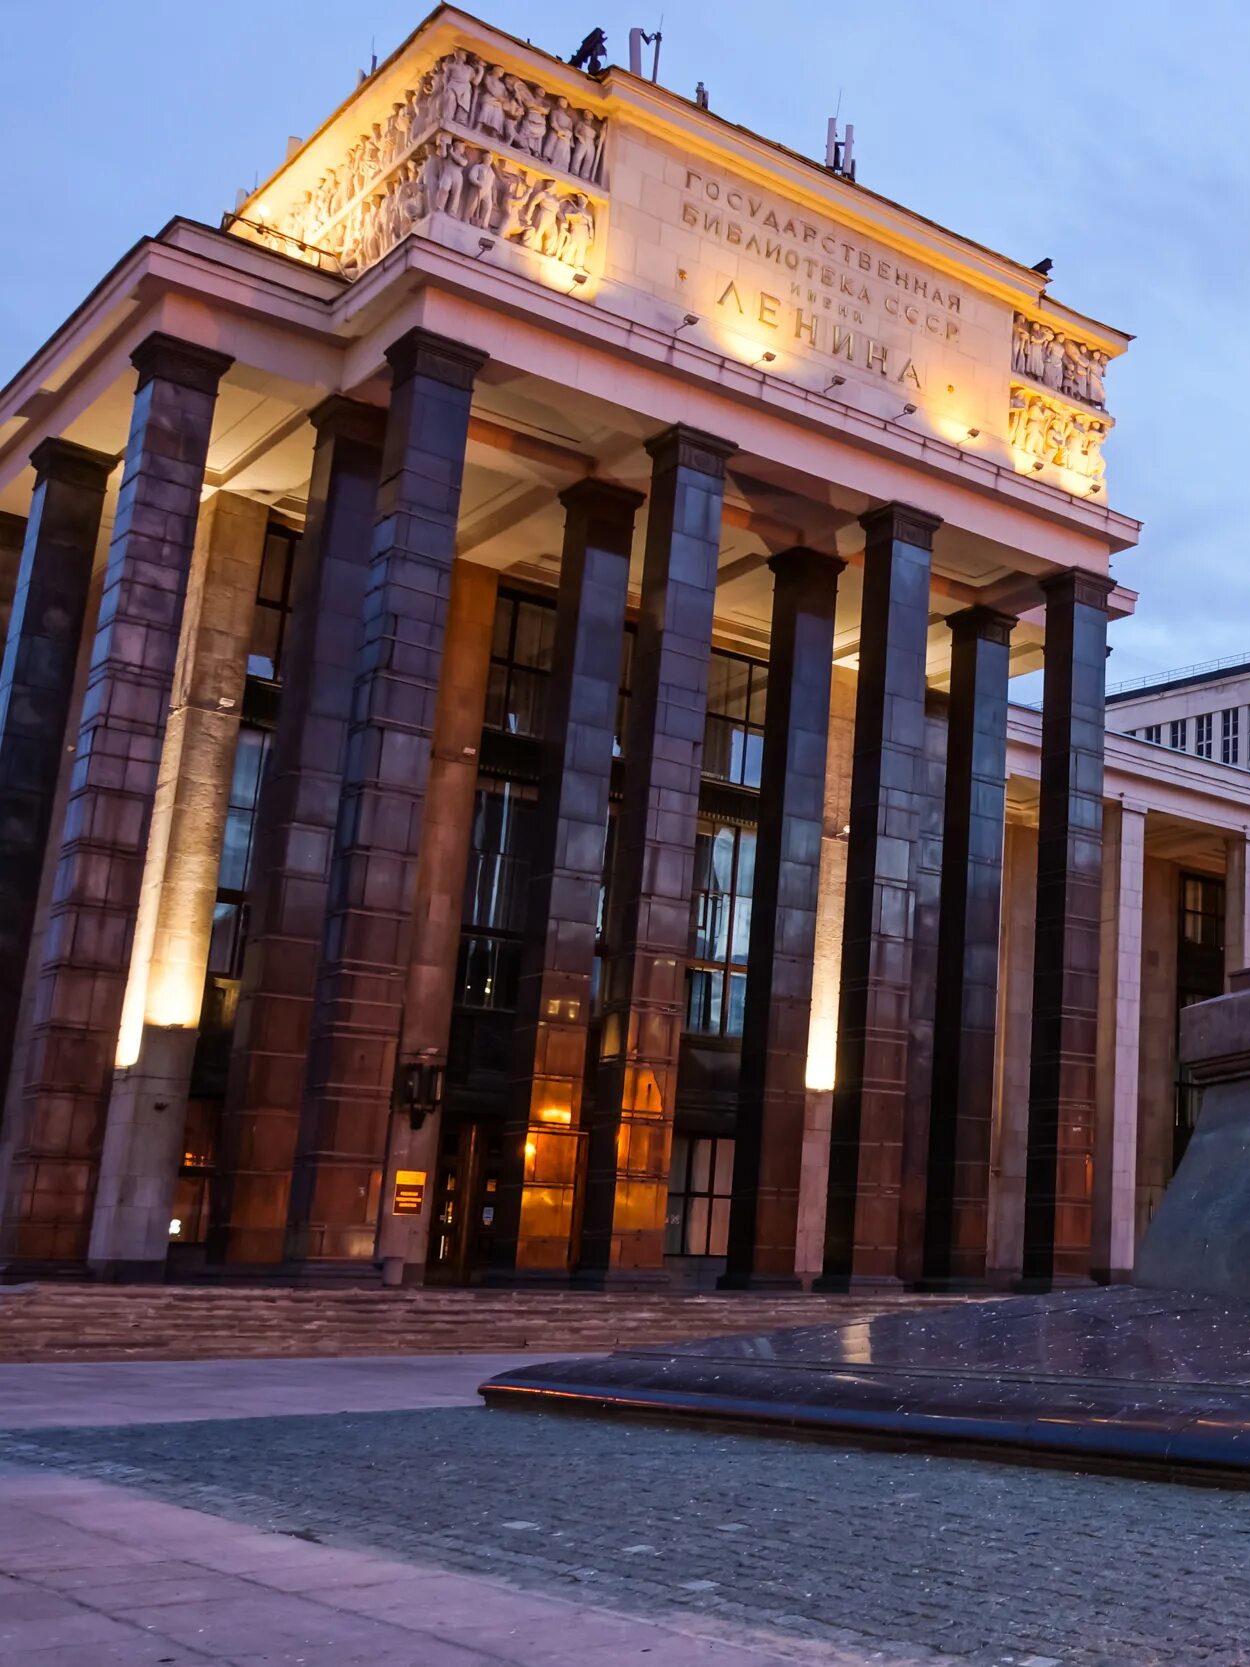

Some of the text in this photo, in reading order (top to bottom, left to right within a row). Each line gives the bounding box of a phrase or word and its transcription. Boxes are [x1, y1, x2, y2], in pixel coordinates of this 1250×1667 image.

[682, 202, 871, 305] БИБЛИОТЕКА
[685, 170, 961, 313] ГОСУДАРСТВЕННАЯ
[717, 280, 922, 390] ЛЕНИНА
